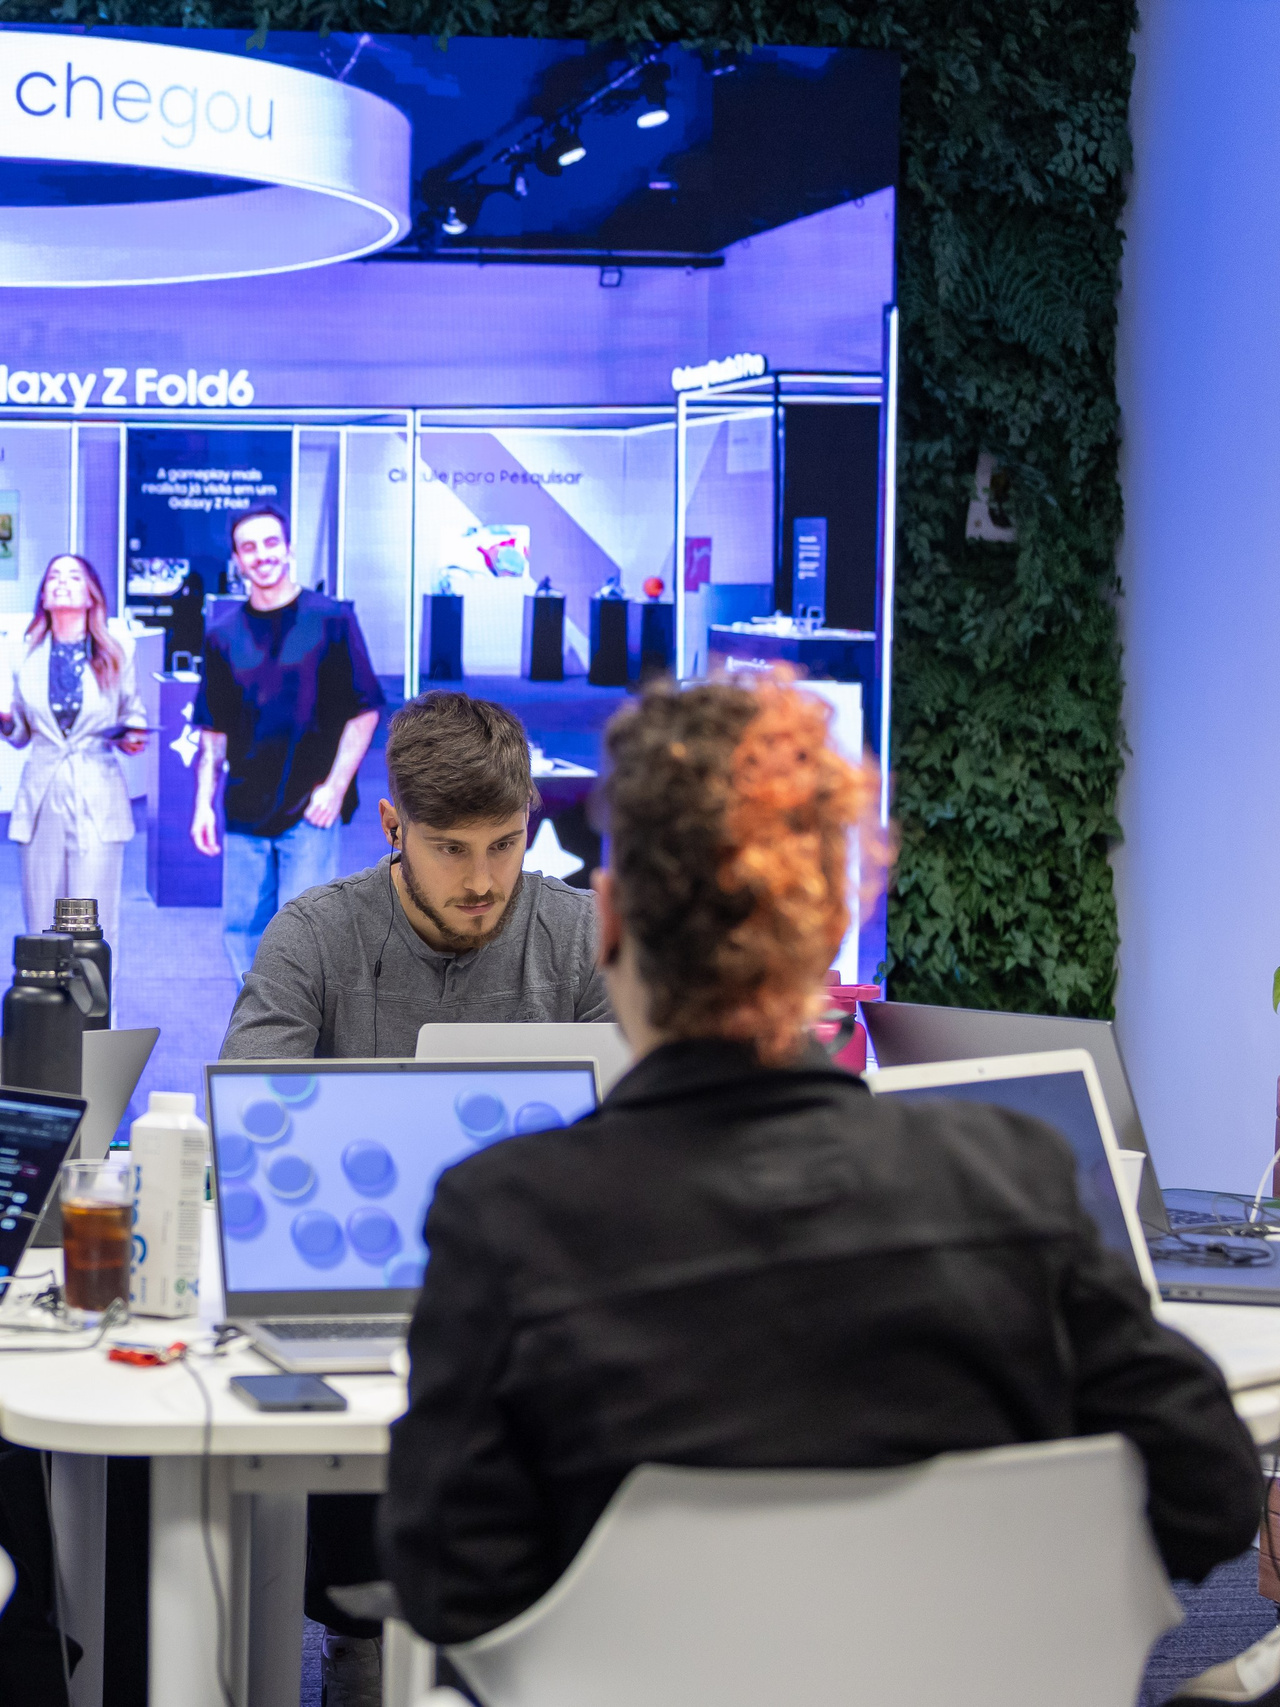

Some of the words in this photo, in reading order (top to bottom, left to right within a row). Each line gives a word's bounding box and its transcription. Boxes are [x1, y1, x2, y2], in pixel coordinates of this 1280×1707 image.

[16, 62, 273, 149] chegou
[102, 367, 127, 405] Z
[135, 368, 255, 406] Fold6
[168, 468, 230, 484] gameplay
[388, 467, 448, 484] Ciule
[452, 471, 495, 489] para
[500, 469, 583, 489] Pesquisar
[167, 496, 213, 512] Galaxy
